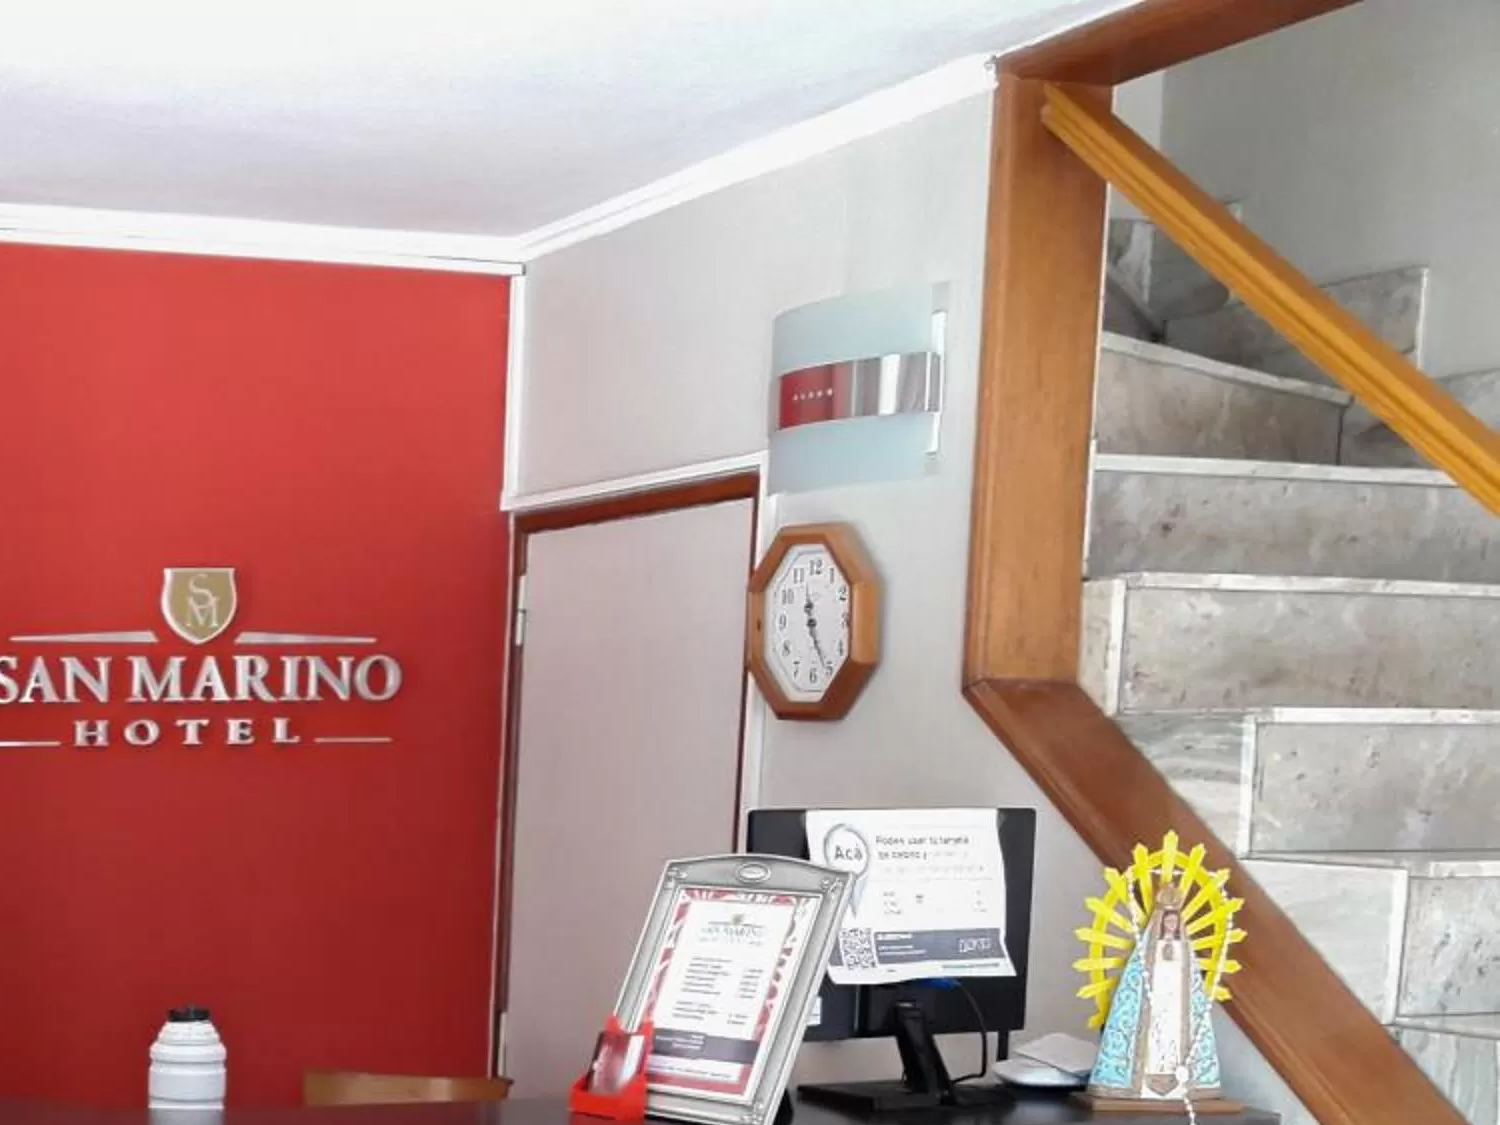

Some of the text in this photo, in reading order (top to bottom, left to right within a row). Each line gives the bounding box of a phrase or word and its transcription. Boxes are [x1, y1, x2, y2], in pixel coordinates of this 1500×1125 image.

[810, 560, 823, 575] 12
[794, 568, 805, 584] 11
[782, 589, 794, 605] 10
[838, 586, 847, 601] 2
[779, 614, 787, 631] 9
[126, 654, 403, 703] MARINO
[809, 668, 817, 684] 6
[73, 717, 302, 747] HOTEL
